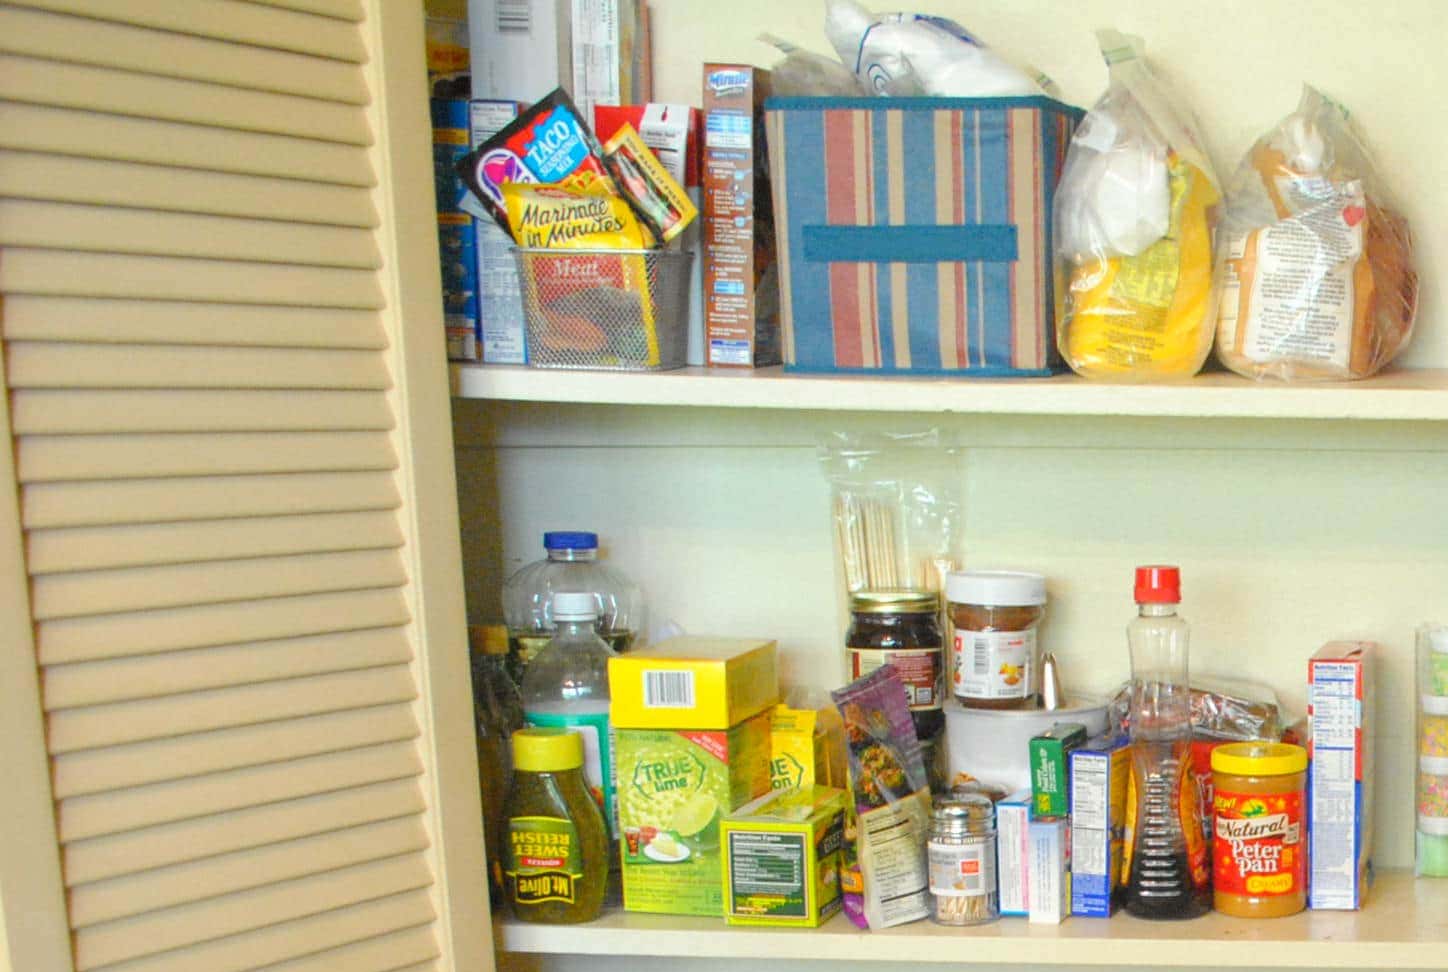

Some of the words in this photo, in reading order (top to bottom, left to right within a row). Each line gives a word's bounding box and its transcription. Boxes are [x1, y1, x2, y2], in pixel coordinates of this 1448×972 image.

[528, 119, 571, 166] TACO
[518, 199, 609, 232] Marinade
[527, 231, 542, 248] in
[546, 217, 627, 248] Minutes
[643, 757, 692, 782] TRUE
[654, 777, 688, 793] lime
[512, 831, 570, 845] RELISH
[1223, 816, 1286, 838] Natural
[515, 844, 570, 858] SWEET
[1228, 839, 1283, 859] Peter
[519, 875, 551, 897] Olive
